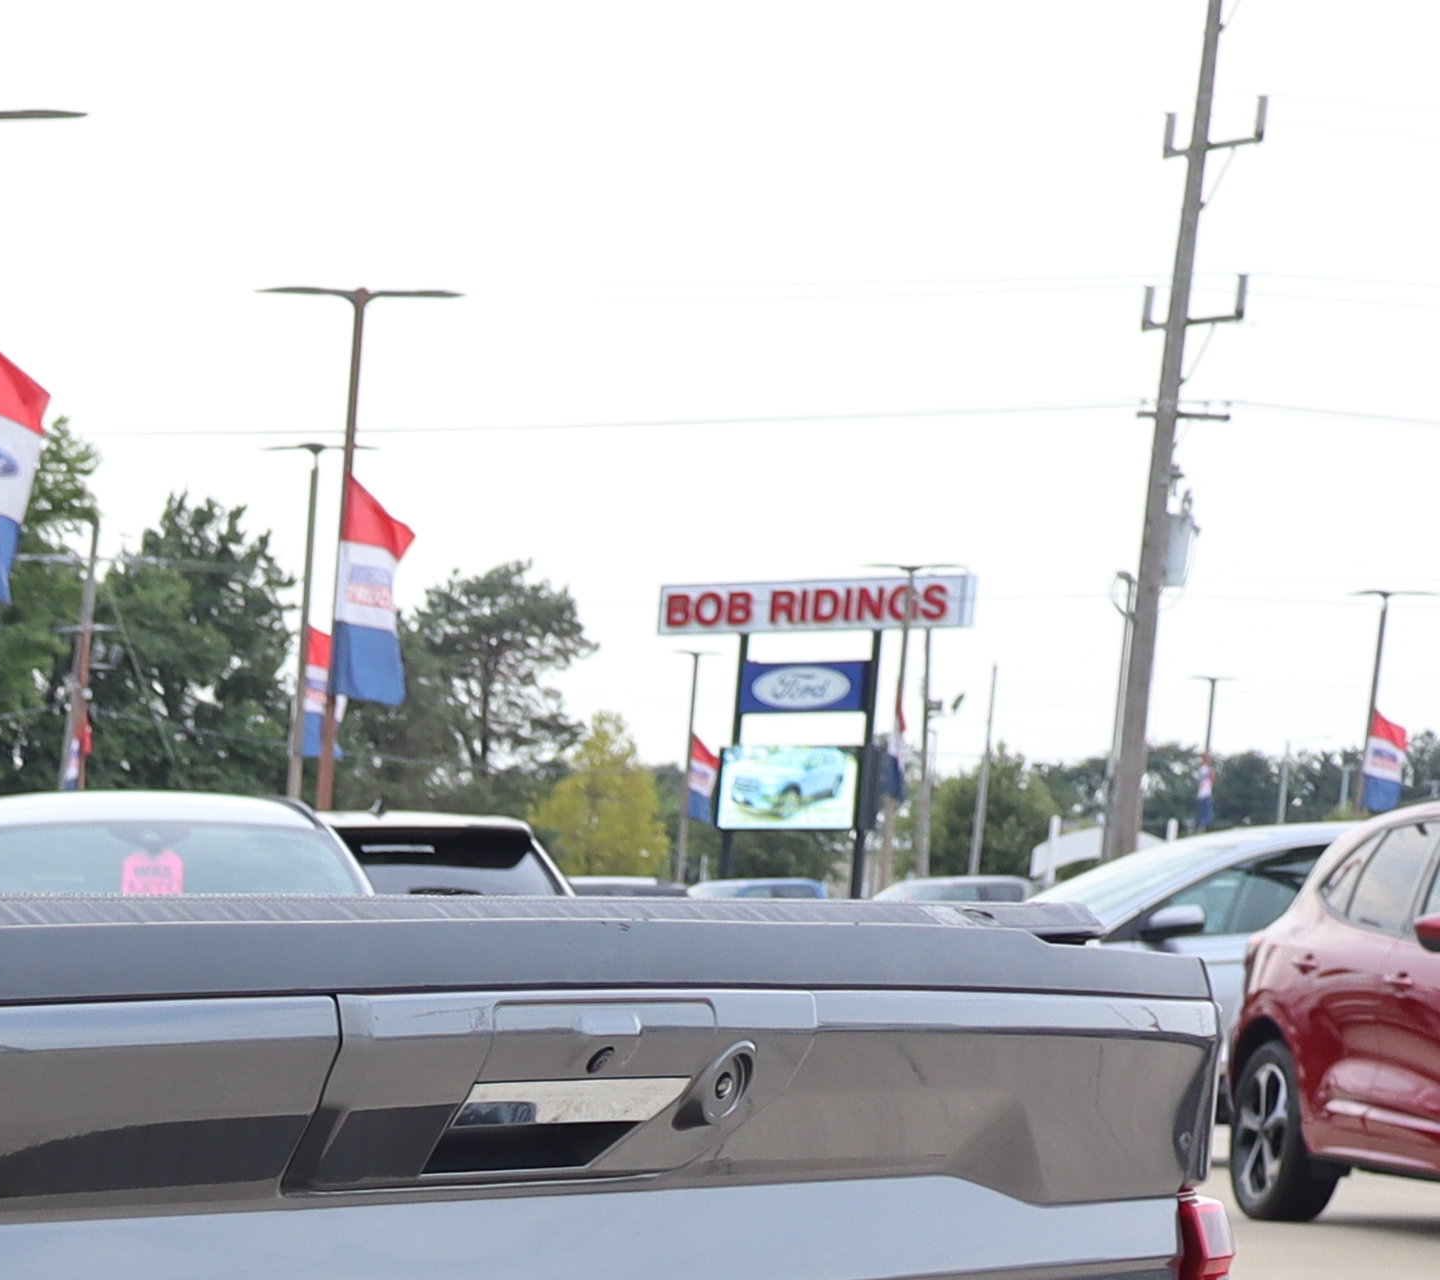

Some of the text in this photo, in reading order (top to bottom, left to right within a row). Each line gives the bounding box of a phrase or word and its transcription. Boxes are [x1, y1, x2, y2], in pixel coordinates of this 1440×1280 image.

[666, 583, 948, 628] BOB RIDINGS
[770, 672, 831, 701] Ford
